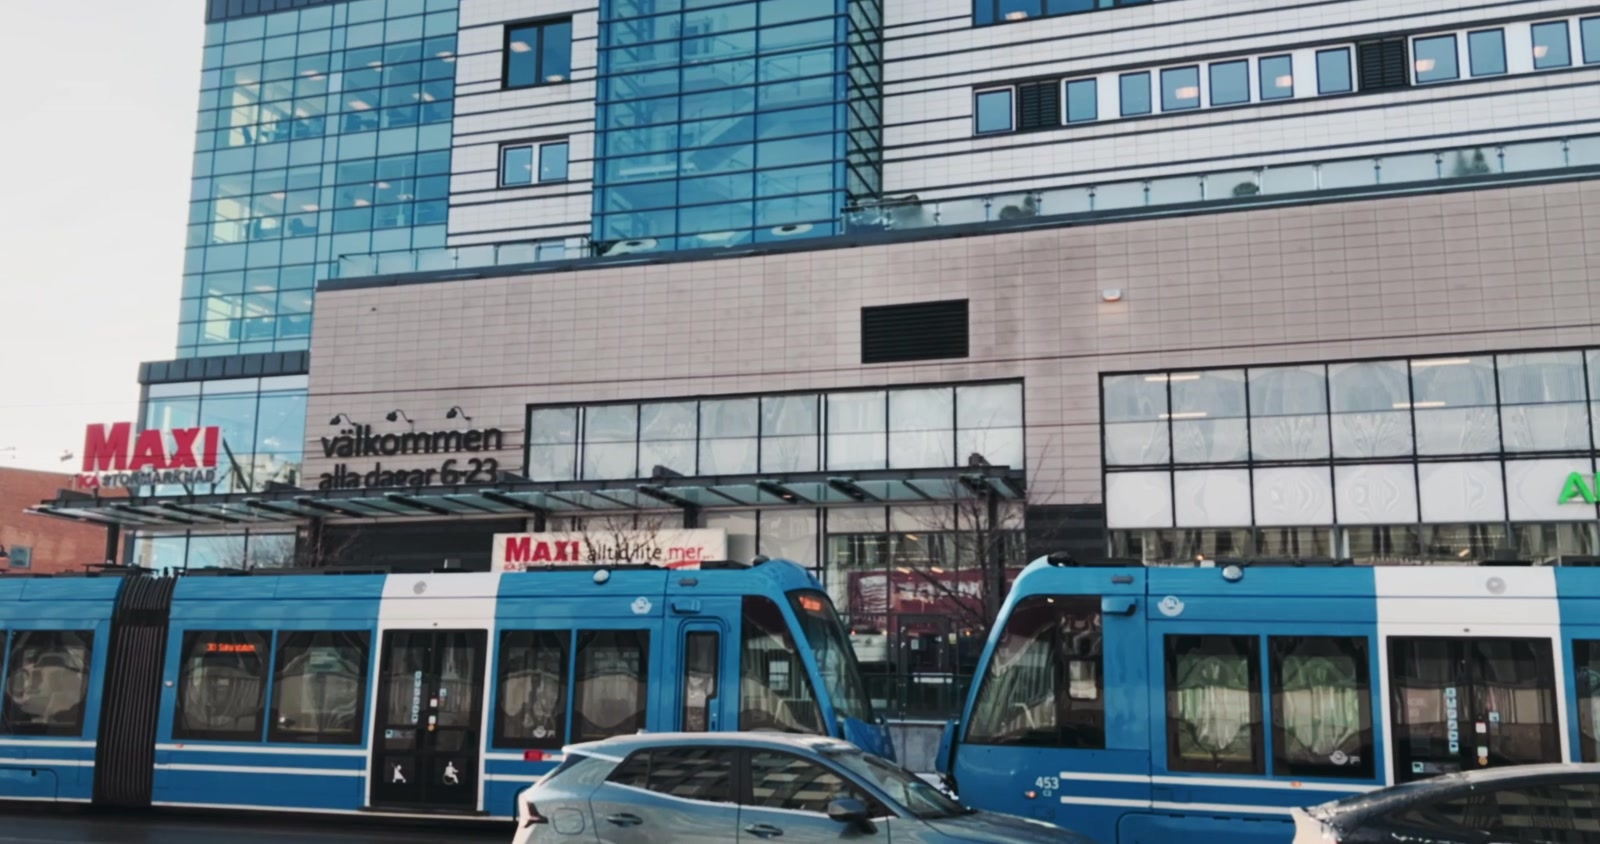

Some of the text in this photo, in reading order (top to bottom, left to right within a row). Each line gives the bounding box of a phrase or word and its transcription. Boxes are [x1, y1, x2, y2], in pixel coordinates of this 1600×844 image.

[82, 421, 220, 472] MAXI
[320, 424, 503, 458] välkommen
[78, 474, 100, 488] ICA
[318, 463, 361, 490] alla
[440, 458, 499, 486] 6-23
[1557, 471, 1600, 505] A
[504, 536, 580, 562] MAXI
[1035, 776, 1059, 790] 453
